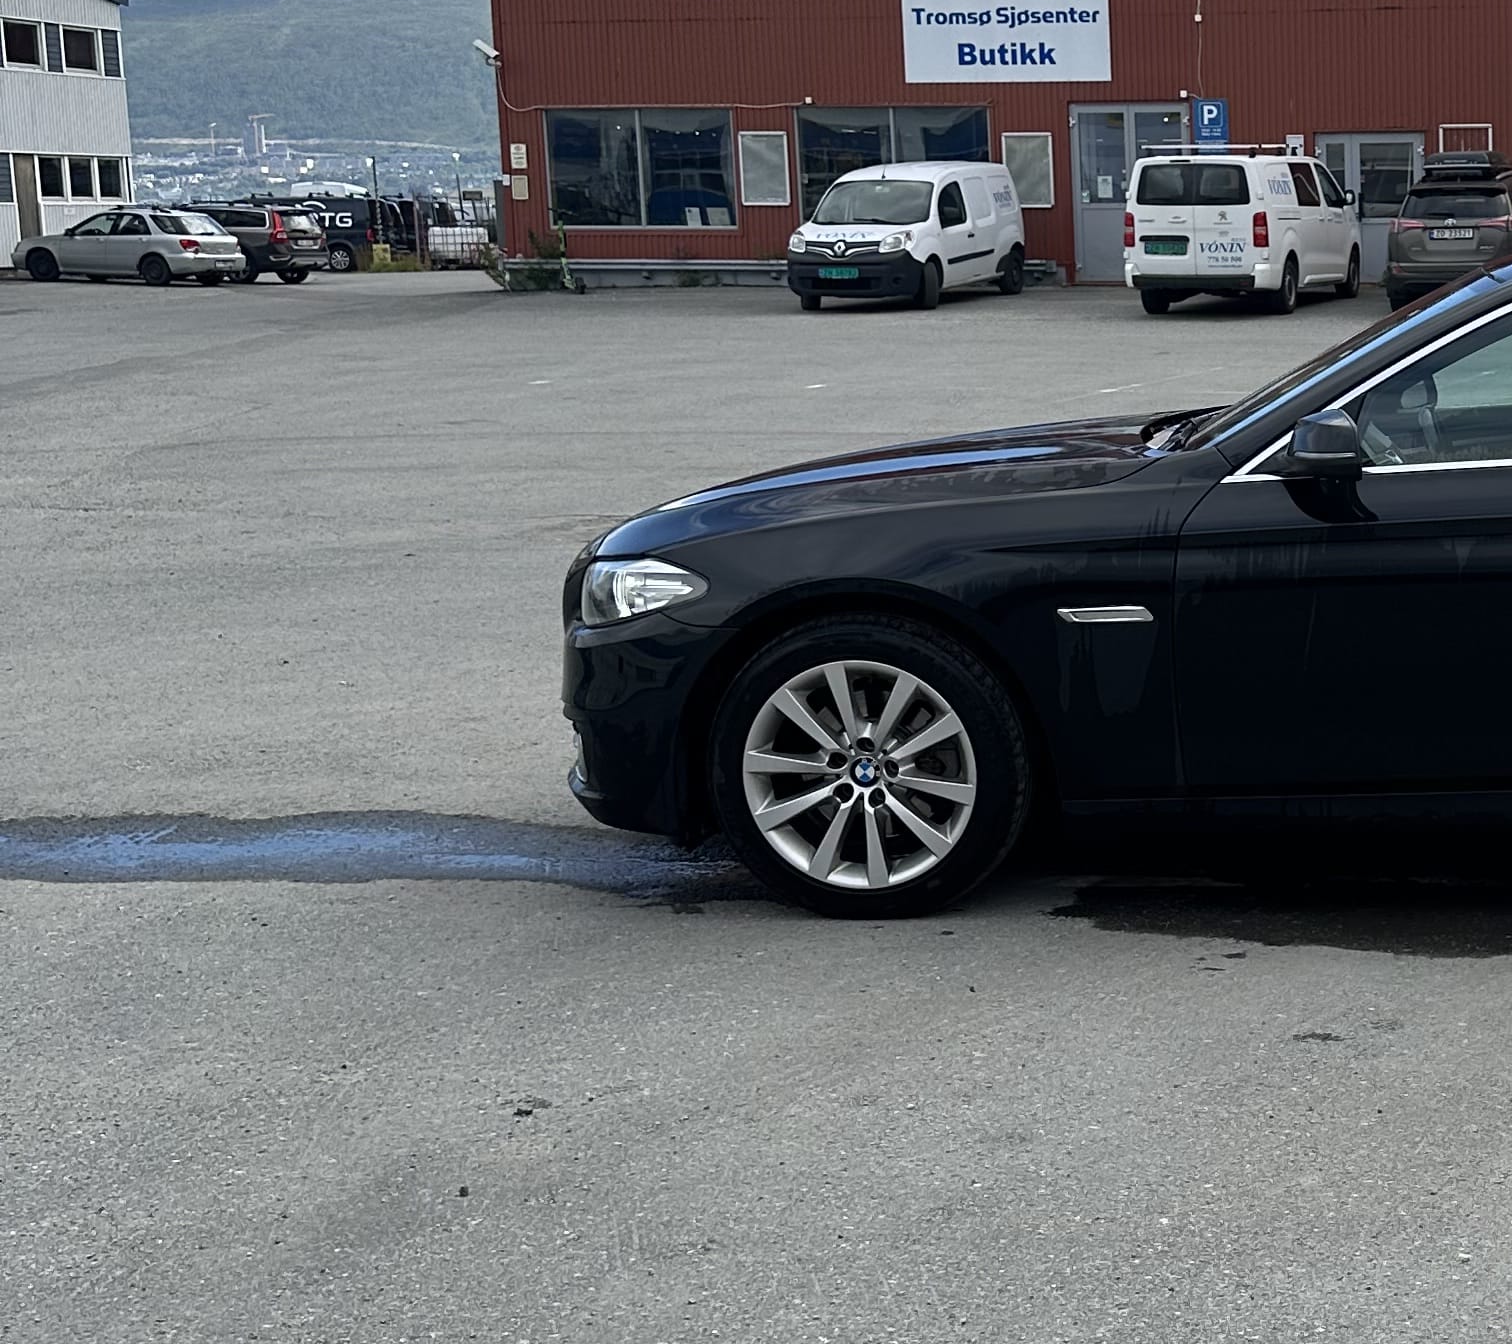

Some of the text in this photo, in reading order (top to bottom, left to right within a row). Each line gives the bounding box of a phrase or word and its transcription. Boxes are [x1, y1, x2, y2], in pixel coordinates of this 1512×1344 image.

[911, 6, 1100, 28] Tromsø Sjøsenter
[957, 42, 1056, 66] Butikk
[1203, 105, 1218, 125] P
